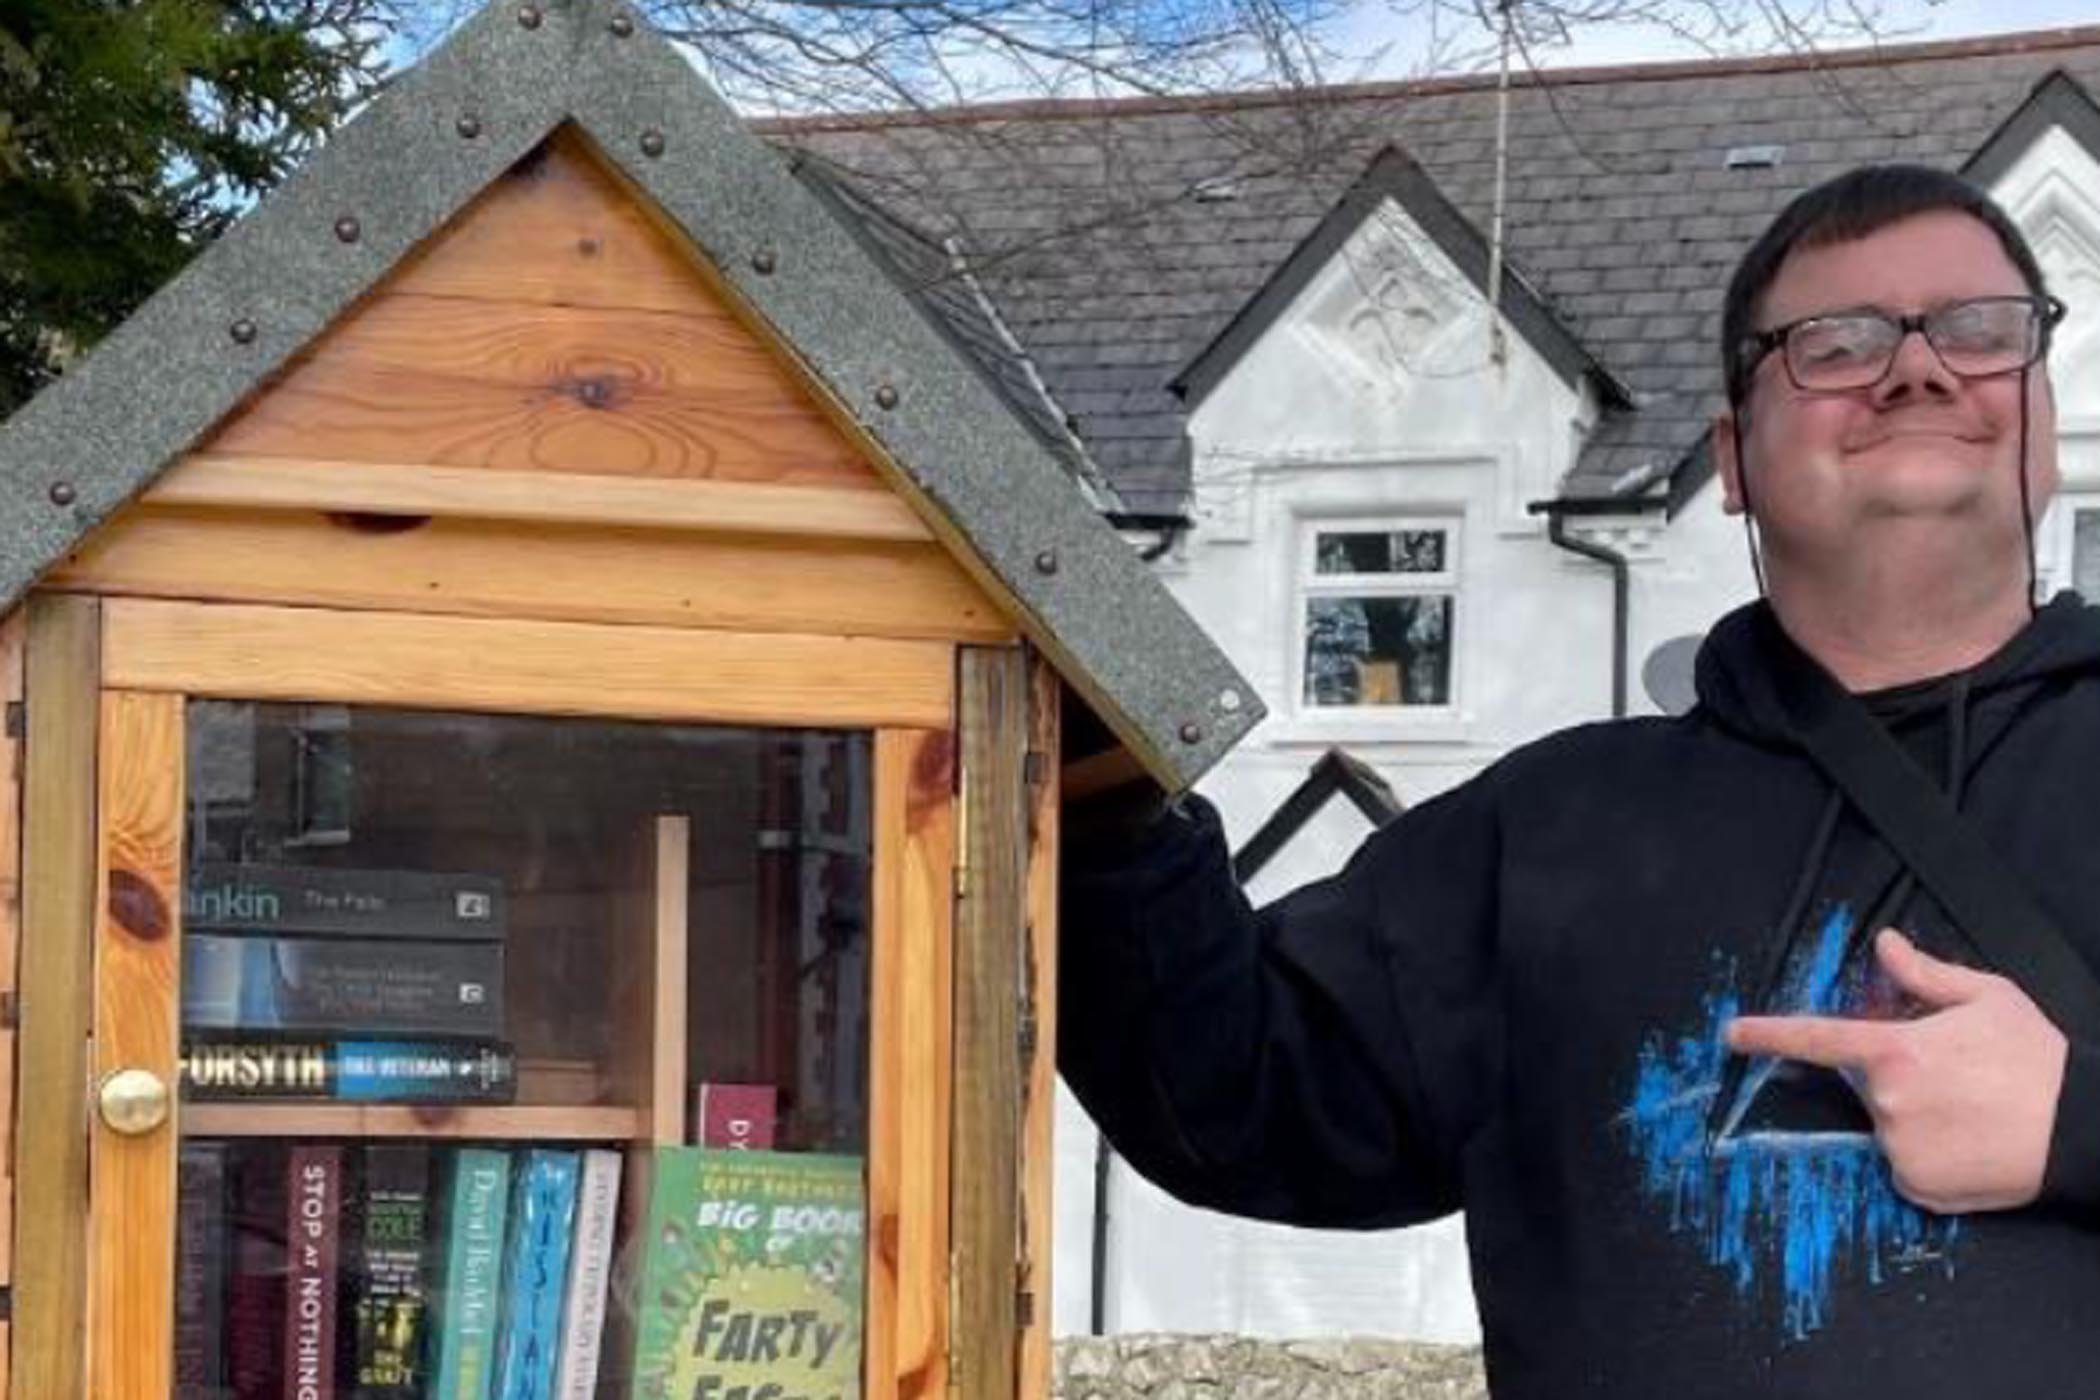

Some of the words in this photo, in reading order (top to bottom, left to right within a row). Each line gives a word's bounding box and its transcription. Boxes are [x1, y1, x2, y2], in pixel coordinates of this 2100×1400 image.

[180, 1044, 325, 1087] ORSYTH
[301, 1164, 326, 1237] STOP
[304, 1244, 318, 1268] AT
[297, 1277, 323, 1400] NOTHING
